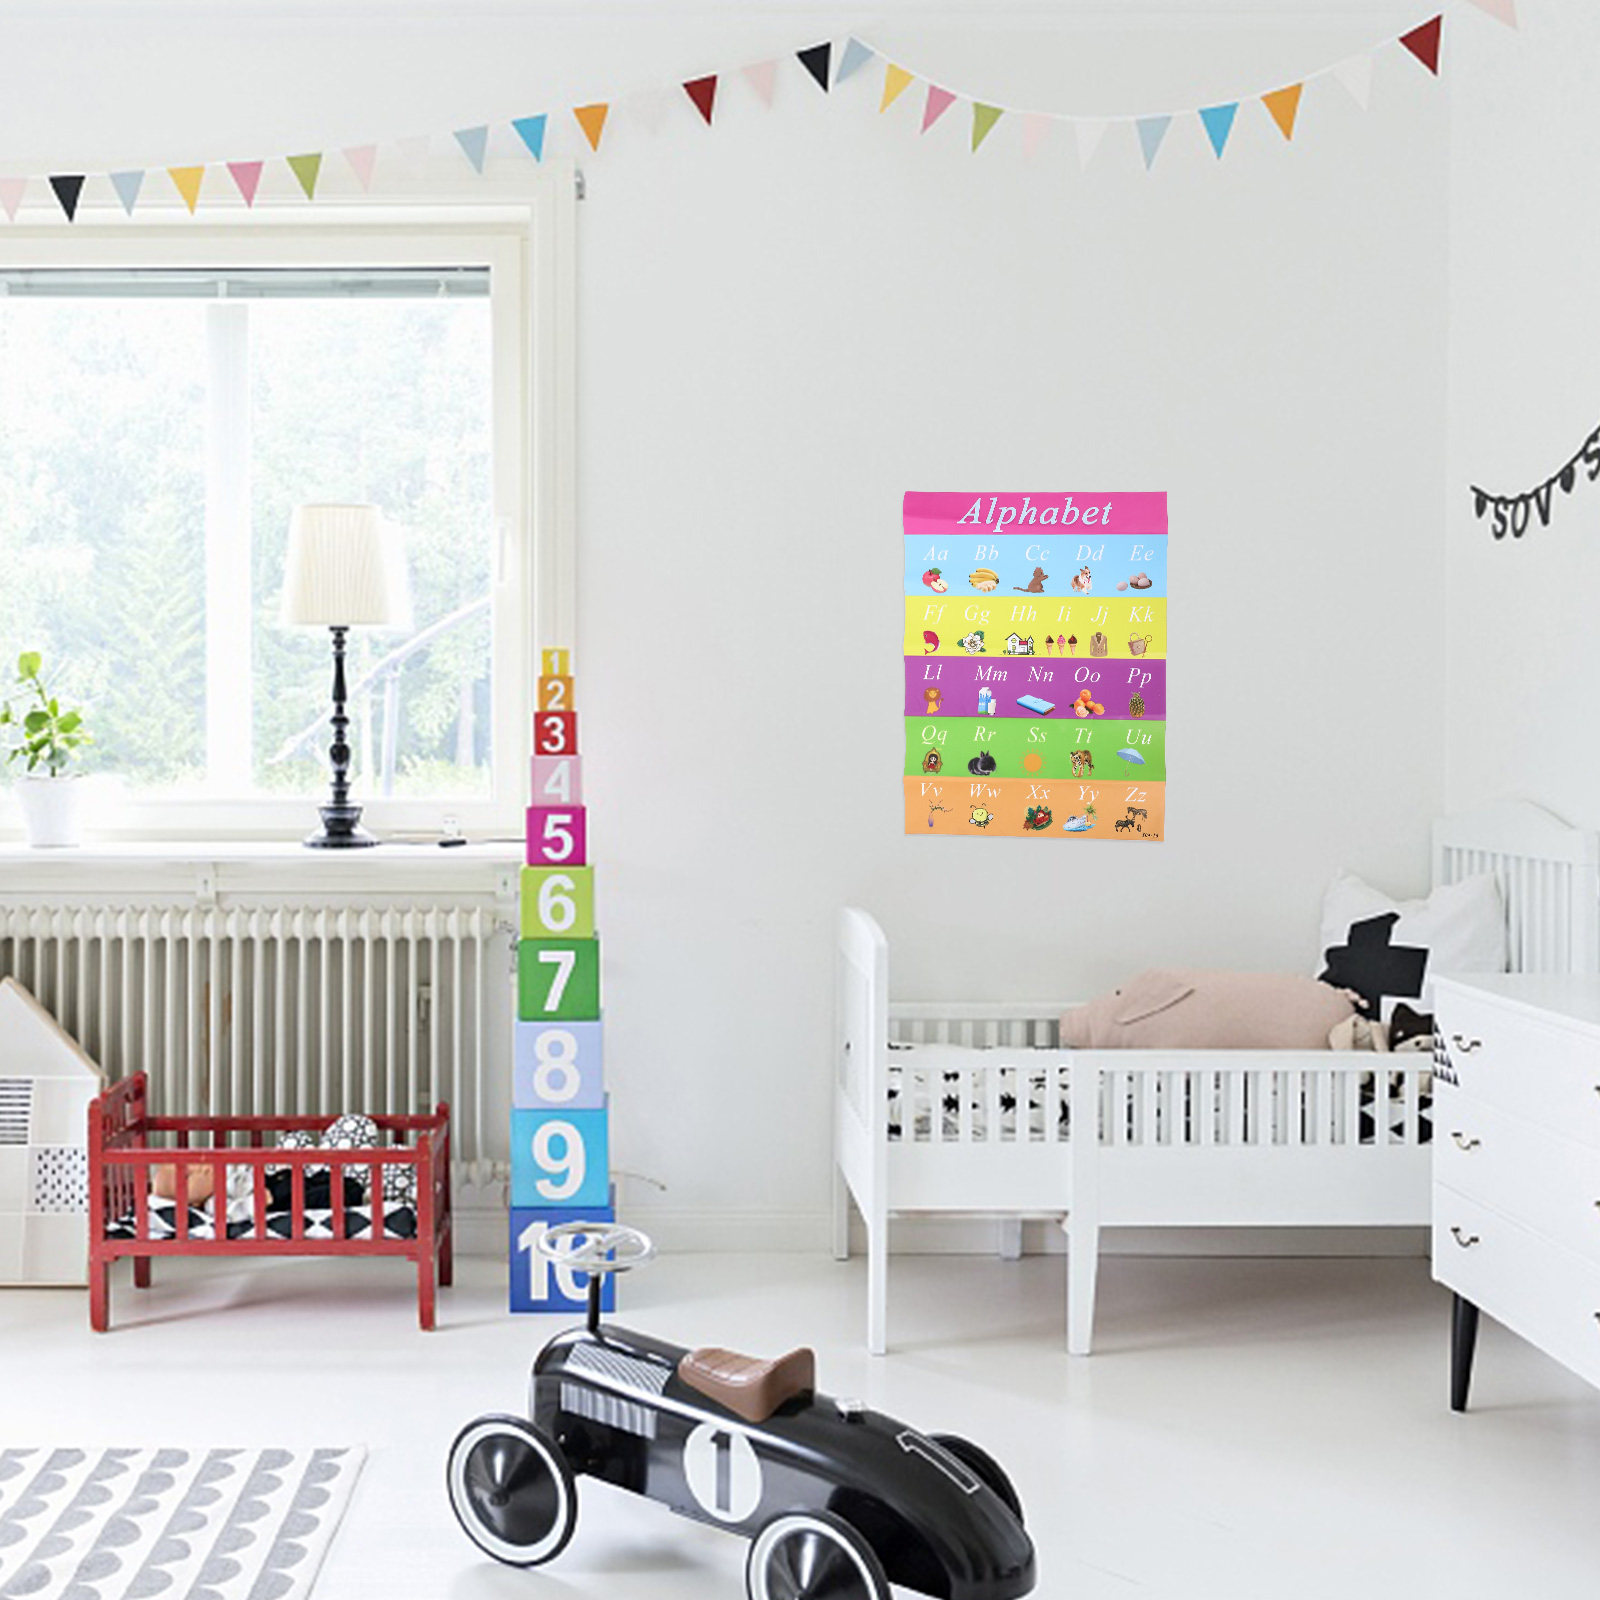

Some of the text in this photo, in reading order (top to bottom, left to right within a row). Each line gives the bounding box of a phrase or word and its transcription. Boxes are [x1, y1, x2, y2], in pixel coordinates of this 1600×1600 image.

[957, 497, 1113, 533] Alphabet
[923, 545, 1155, 561] Aa Bb Cc Dd Ee
[923, 605, 1154, 626] Ff Gg Hh Ii Jj Kk
[550, 651, 559, 674] 1
[923, 664, 1152, 688] Ll Mm Nn Oo Pp
[546, 679, 565, 711] 2
[542, 717, 565, 752] 3
[921, 725, 1152, 745] Qq Rr Ss Tt Uu
[543, 760, 570, 803] 4
[920, 782, 1147, 804] Vv Ww Xx Yy Zz
[541, 814, 573, 861] 5
[538, 874, 576, 932] 6
[538, 950, 575, 1012] 7
[533, 1029, 581, 1103] 8
[532, 1120, 586, 1200] 9
[710, 1430, 731, 1513] 1
[896, 1430, 980, 1494] 1
